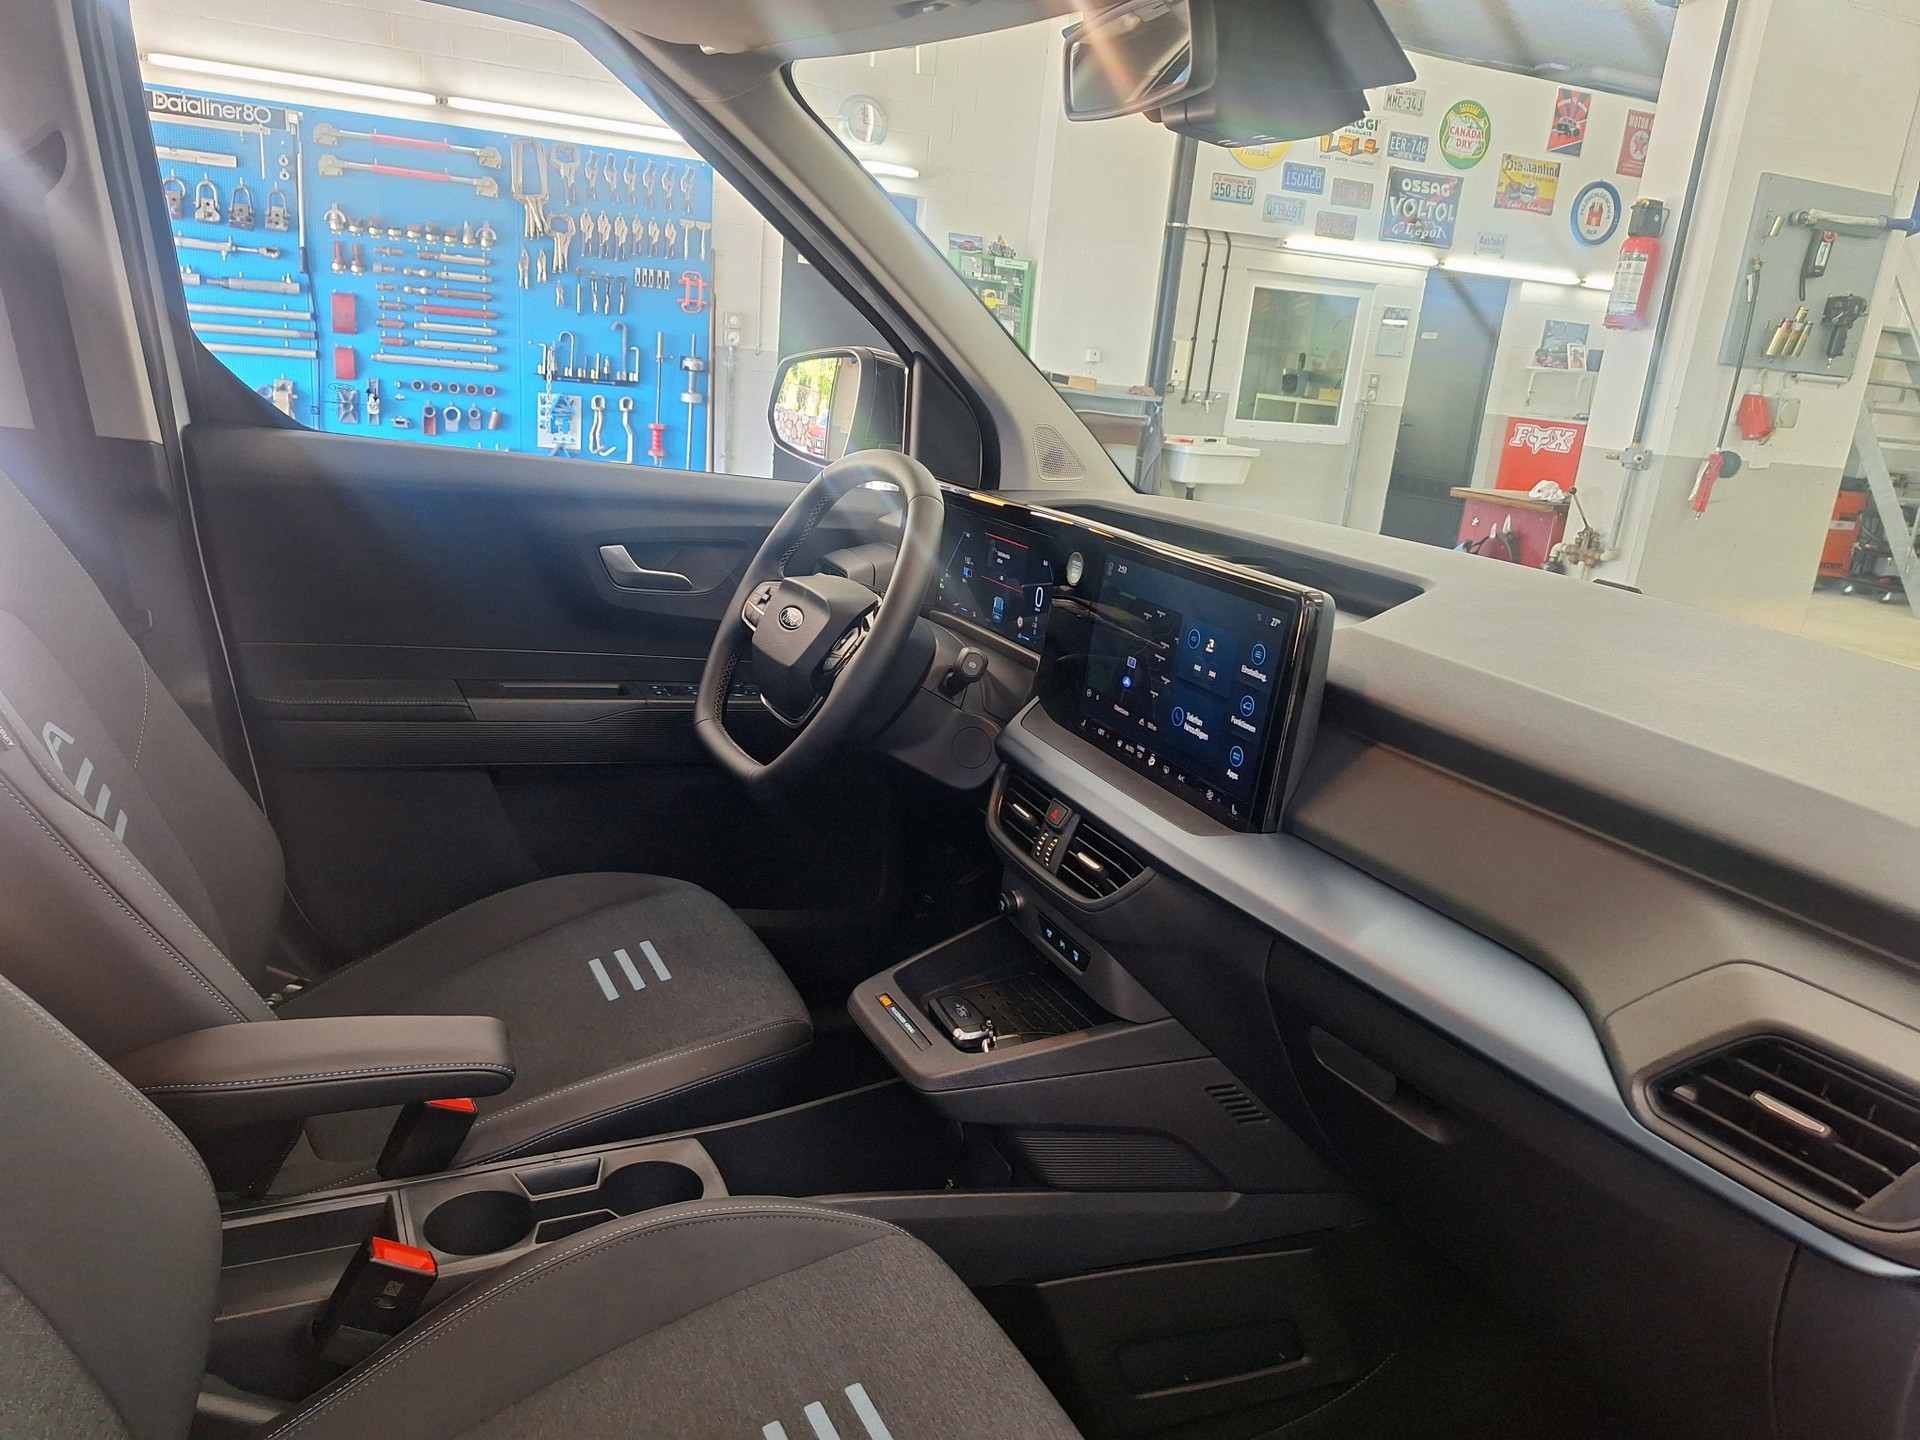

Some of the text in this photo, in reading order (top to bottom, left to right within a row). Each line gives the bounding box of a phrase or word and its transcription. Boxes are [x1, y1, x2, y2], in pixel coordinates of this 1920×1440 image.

[152, 91, 271, 124] Dataliner80
[1449, 126, 1484, 140] CANADA
[1456, 139, 1473, 149] DRY
[1401, 178, 1450, 197] OSSAG
[1389, 196, 1454, 222] VOLTOL
[1510, 424, 1576, 453] FOX
[1034, 586, 1044, 608] 0
[1226, 768, 1239, 781] Apps
